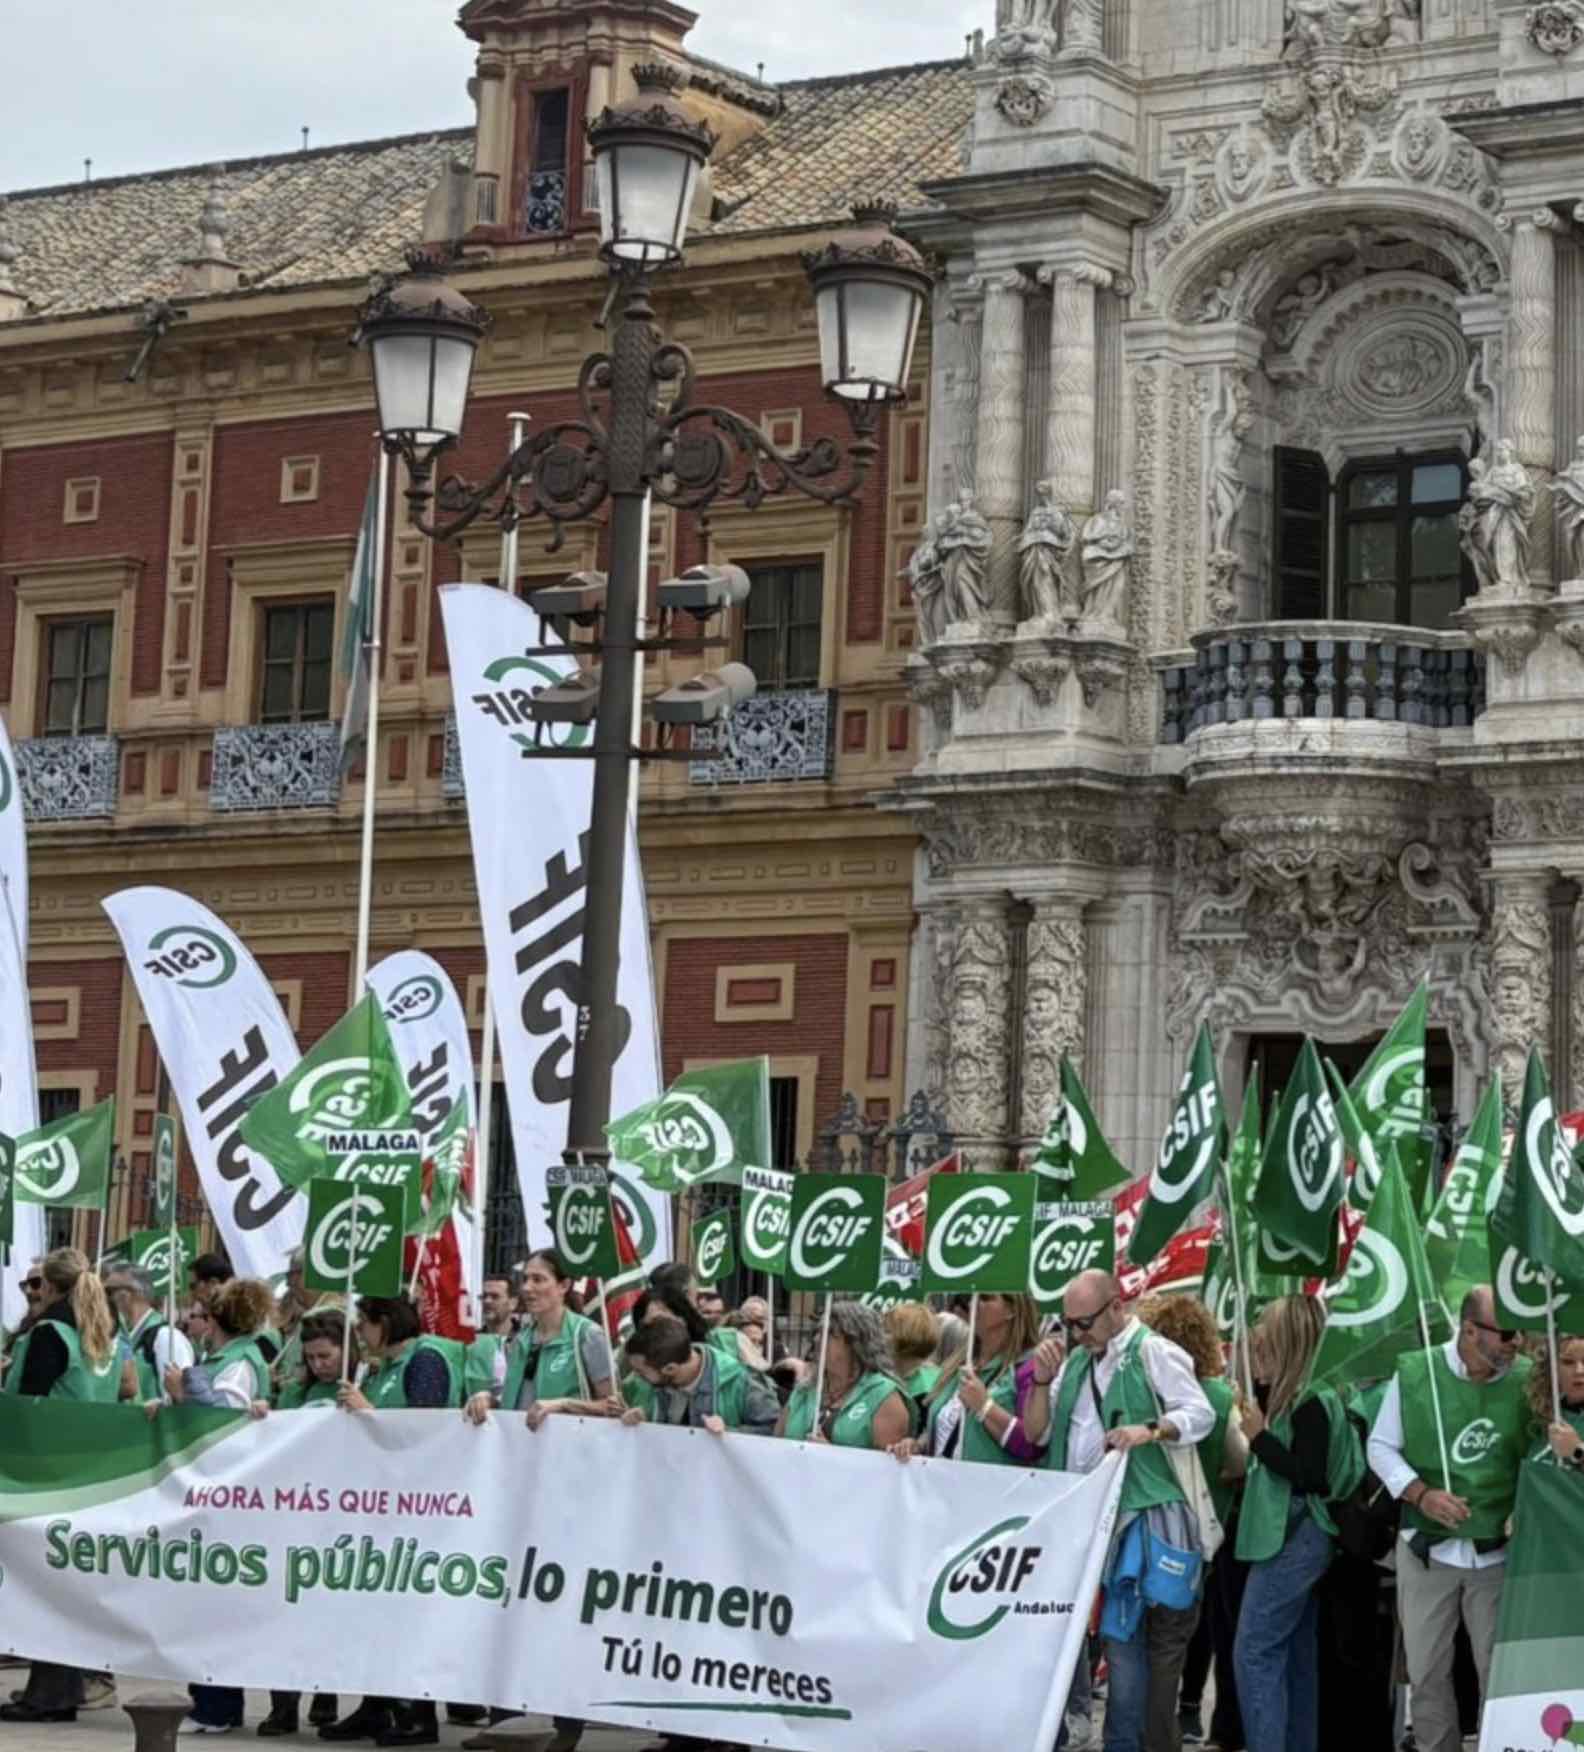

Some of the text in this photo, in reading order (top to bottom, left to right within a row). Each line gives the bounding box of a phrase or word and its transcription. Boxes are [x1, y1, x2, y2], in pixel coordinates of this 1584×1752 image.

[565, 1204, 605, 1235] CSIF
[756, 1203, 790, 1237] CSI
[806, 1214, 873, 1248] CSIF
[946, 1213, 1021, 1248] CSIF
[1038, 1239, 1104, 1272] CSIF
[184, 1483, 473, 1518] AHORA MÁS QUE NUNCA
[45, 1519, 269, 1587] Servicios
[518, 1546, 565, 1603] lo
[579, 1560, 794, 1637] primero
[602, 1636, 833, 1705] Tú lo mereces
